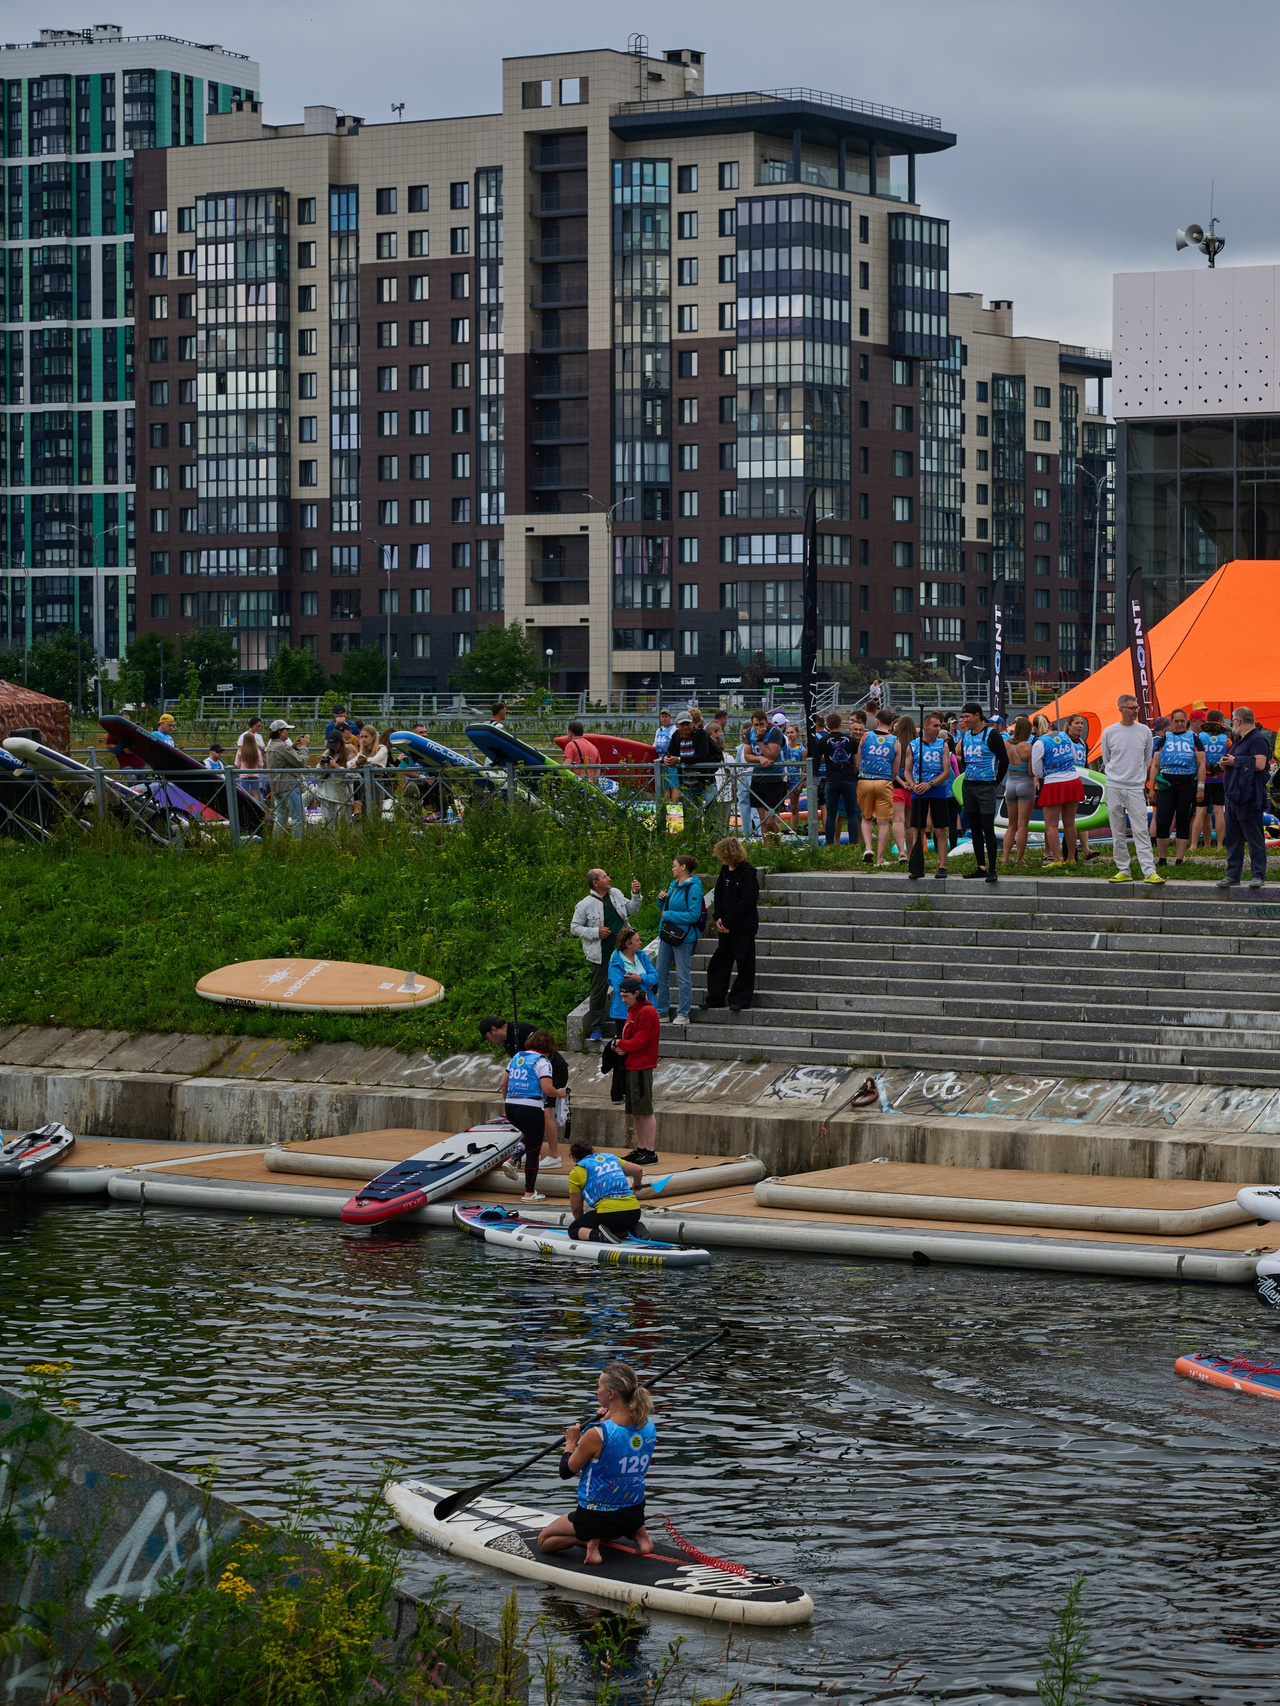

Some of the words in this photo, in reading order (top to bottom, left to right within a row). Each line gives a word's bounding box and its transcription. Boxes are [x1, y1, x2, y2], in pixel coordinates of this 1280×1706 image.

[868, 744, 889, 756] 269
[1052, 745, 1071, 758] 266
[1166, 741, 1191, 752] 310
[1204, 744, 1223, 753] 107
[923, 751, 940, 762] 68
[509, 1068, 528, 1080] 302
[483, 1156, 499, 1171] AQUA
[594, 1161, 621, 1177] 222
[619, 1454, 650, 1474] 129
